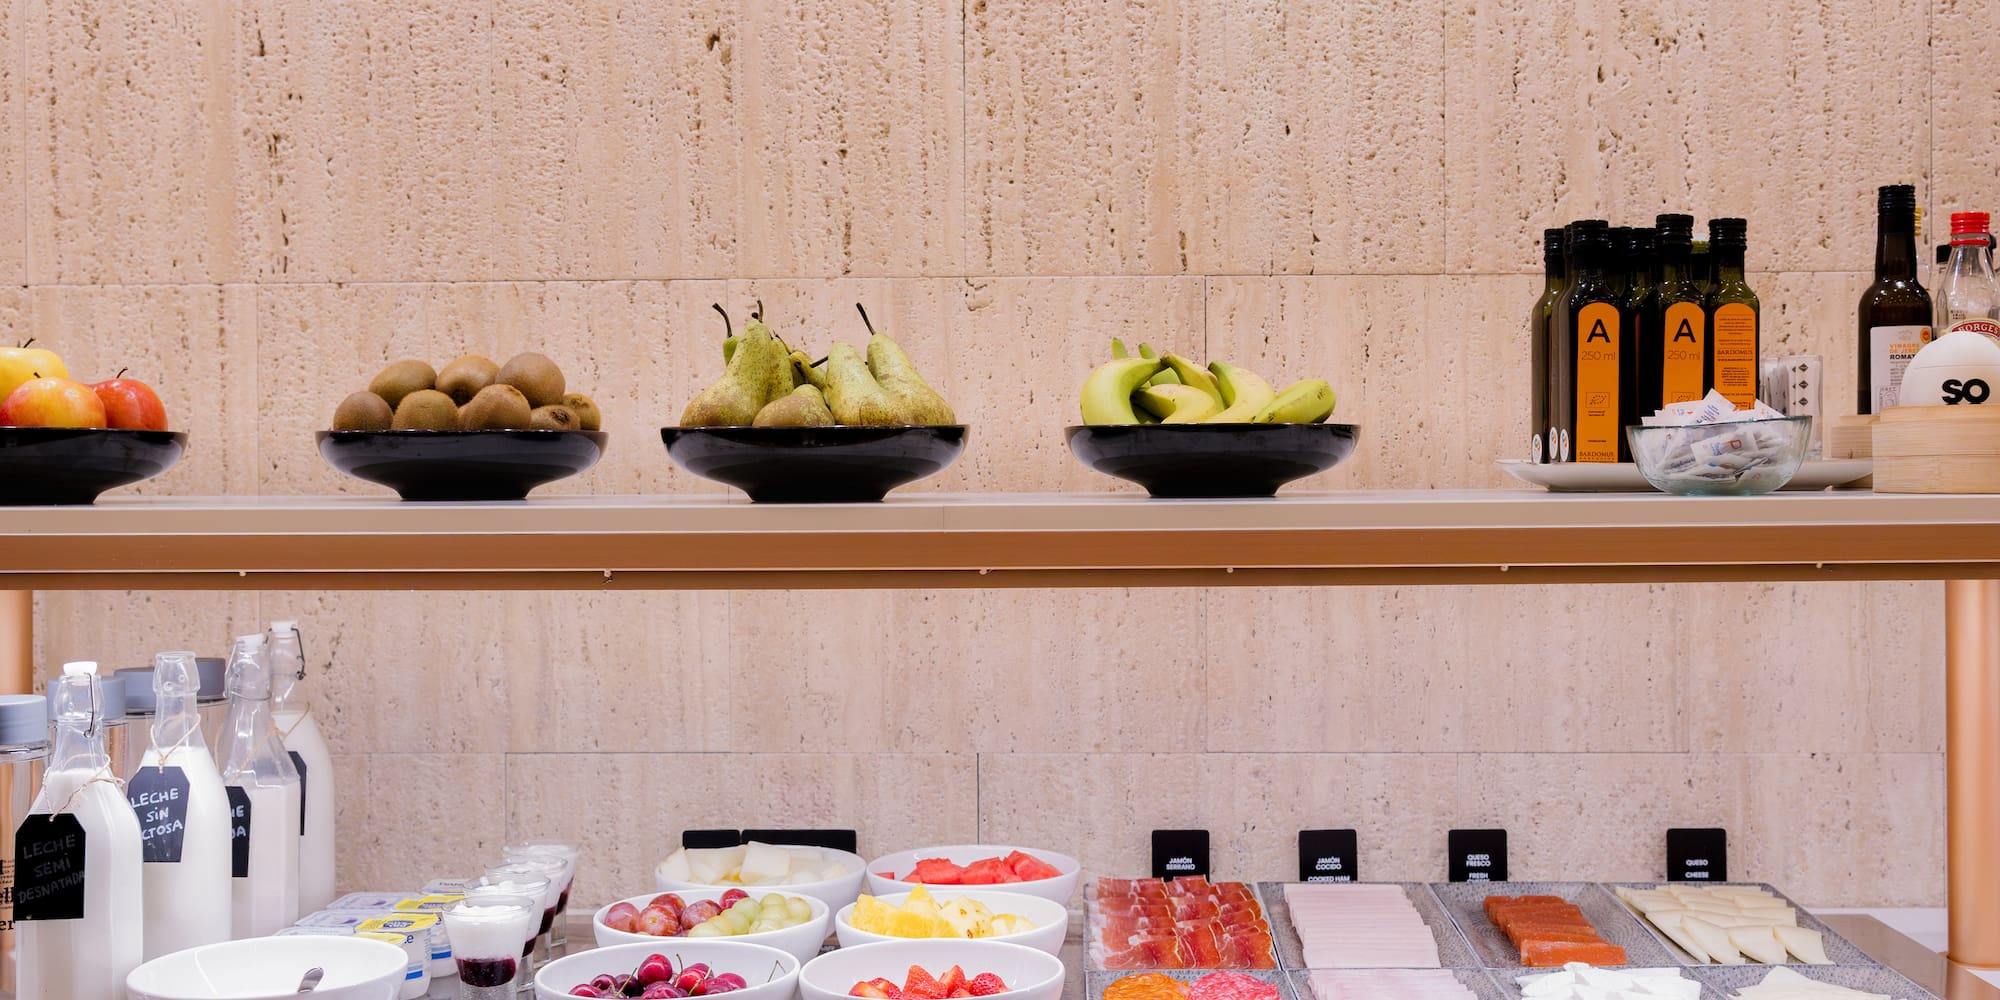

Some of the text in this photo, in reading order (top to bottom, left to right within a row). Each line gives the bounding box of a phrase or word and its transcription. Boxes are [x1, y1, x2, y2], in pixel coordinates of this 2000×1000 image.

[1586, 318, 1611, 343] A
[1673, 318, 1697, 343] A
[1581, 350, 1616, 361] 250 ml
[1667, 350, 1701, 361] 250 ml
[1941, 378, 1991, 405] SO
[130, 787, 180, 809] LECHE
[142, 819, 184, 841] CTOSA
[23, 833, 76, 860] LECHE
[1168, 855, 1193, 864] JAMÓN
[1317, 855, 1341, 864] JAMÓN
[17, 869, 85, 904] DESNATADA
